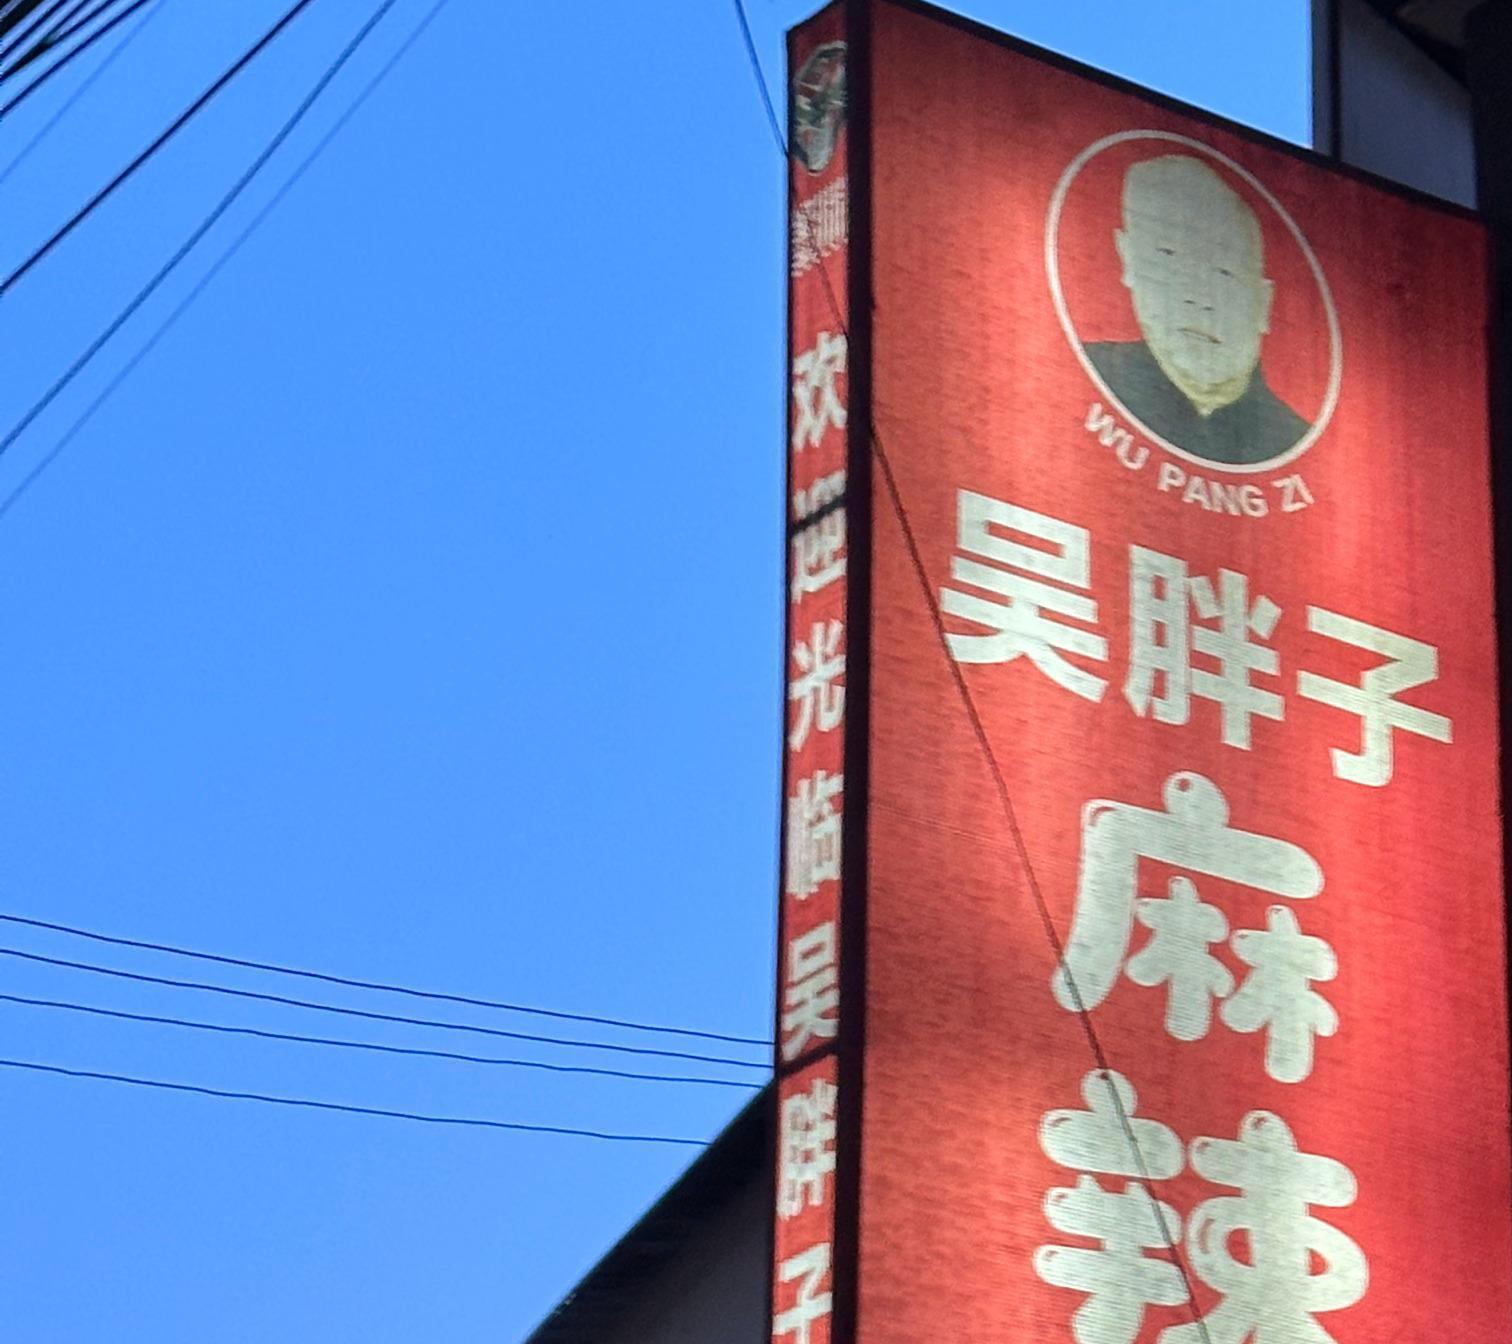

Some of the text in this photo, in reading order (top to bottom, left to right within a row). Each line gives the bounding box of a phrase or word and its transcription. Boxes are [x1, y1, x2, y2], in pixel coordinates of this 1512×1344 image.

[1085, 402, 1315, 518] WU PANG ZI
[939, 488, 1453, 788] 吴胖子
